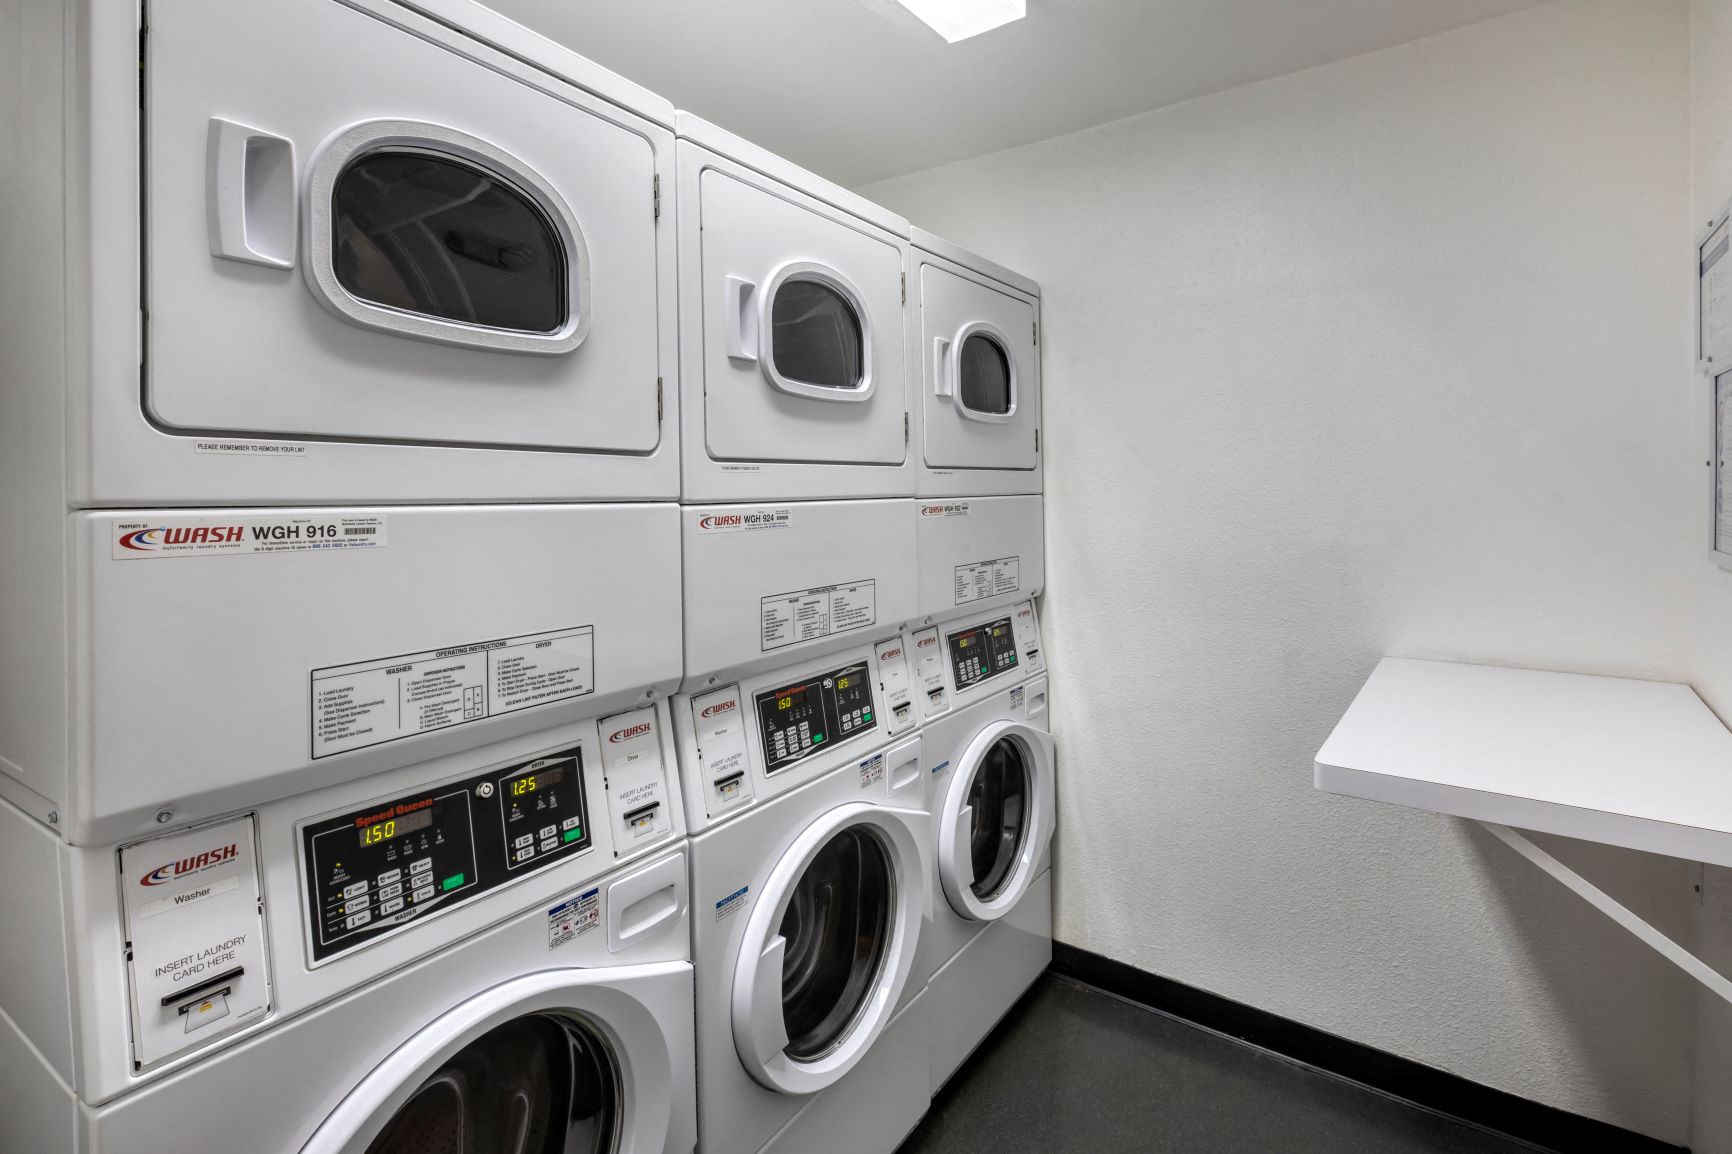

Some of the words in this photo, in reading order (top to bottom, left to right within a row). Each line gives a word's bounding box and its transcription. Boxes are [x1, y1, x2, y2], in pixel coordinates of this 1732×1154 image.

[928, 506, 944, 514] WASH
[714, 516, 742, 526] WASH
[744, 514, 760, 524] WGH
[762, 514, 774, 522] 924
[164, 526, 244, 544] WASH
[252, 526, 300, 540] WGH
[306, 524, 336, 538] 916
[436, 648, 468, 658] OPERATING
[468, 641, 506, 652] INSTRUCTIONS
[386, 665, 412, 675] WASHER
[712, 700, 736, 713] WASH
[623, 722, 650, 738] WASH
[531, 760, 545, 769] DRYER
[627, 754, 639, 762] Dryer
[716, 764, 728, 772] CARD
[728, 760, 740, 768] HERE
[514, 776, 536, 796] 1.25
[619, 788, 636, 800] INSERT
[636, 782, 658, 794] LAUNDRY
[626, 794, 642, 805] CARD
[642, 790, 654, 800] HERE
[356, 808, 395, 828] Speed
[396, 799, 434, 814] Queen
[366, 820, 395, 844] 1.50
[174, 844, 236, 874] WASH
[174, 888, 210, 904] Washer
[394, 908, 417, 922] WASHER
[154, 954, 194, 977] INSERT
[197, 934, 246, 960] LAUNDRY
[173, 963, 205, 982] CARD
[207, 950, 236, 968] HERE
